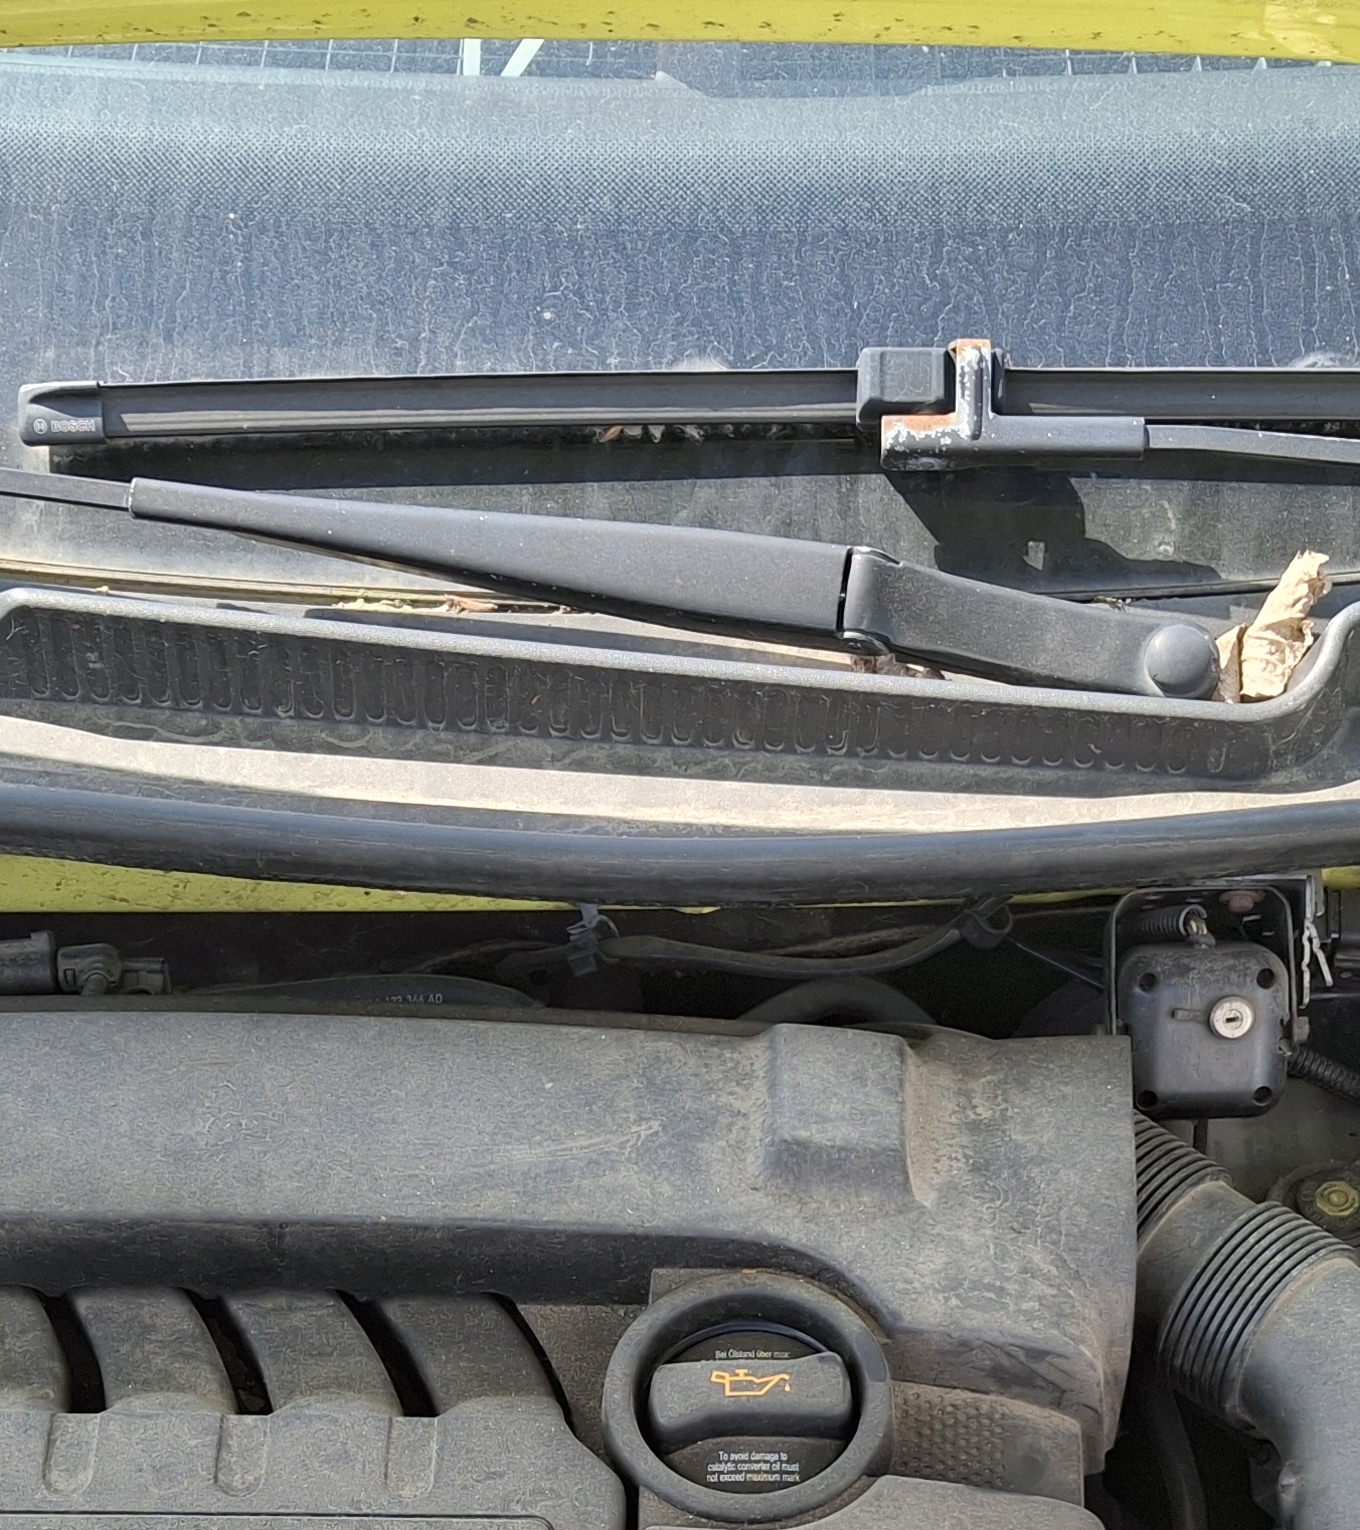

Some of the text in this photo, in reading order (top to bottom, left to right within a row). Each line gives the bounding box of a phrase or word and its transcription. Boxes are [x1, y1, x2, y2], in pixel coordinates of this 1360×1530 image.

[50, 420, 95, 432] BOSCH
[718, 1451, 788, 1462] To avoid damage to
[707, 1461, 799, 1473] catalytic converter oil must
[706, 1472, 800, 1482] not exceed maximum mark
